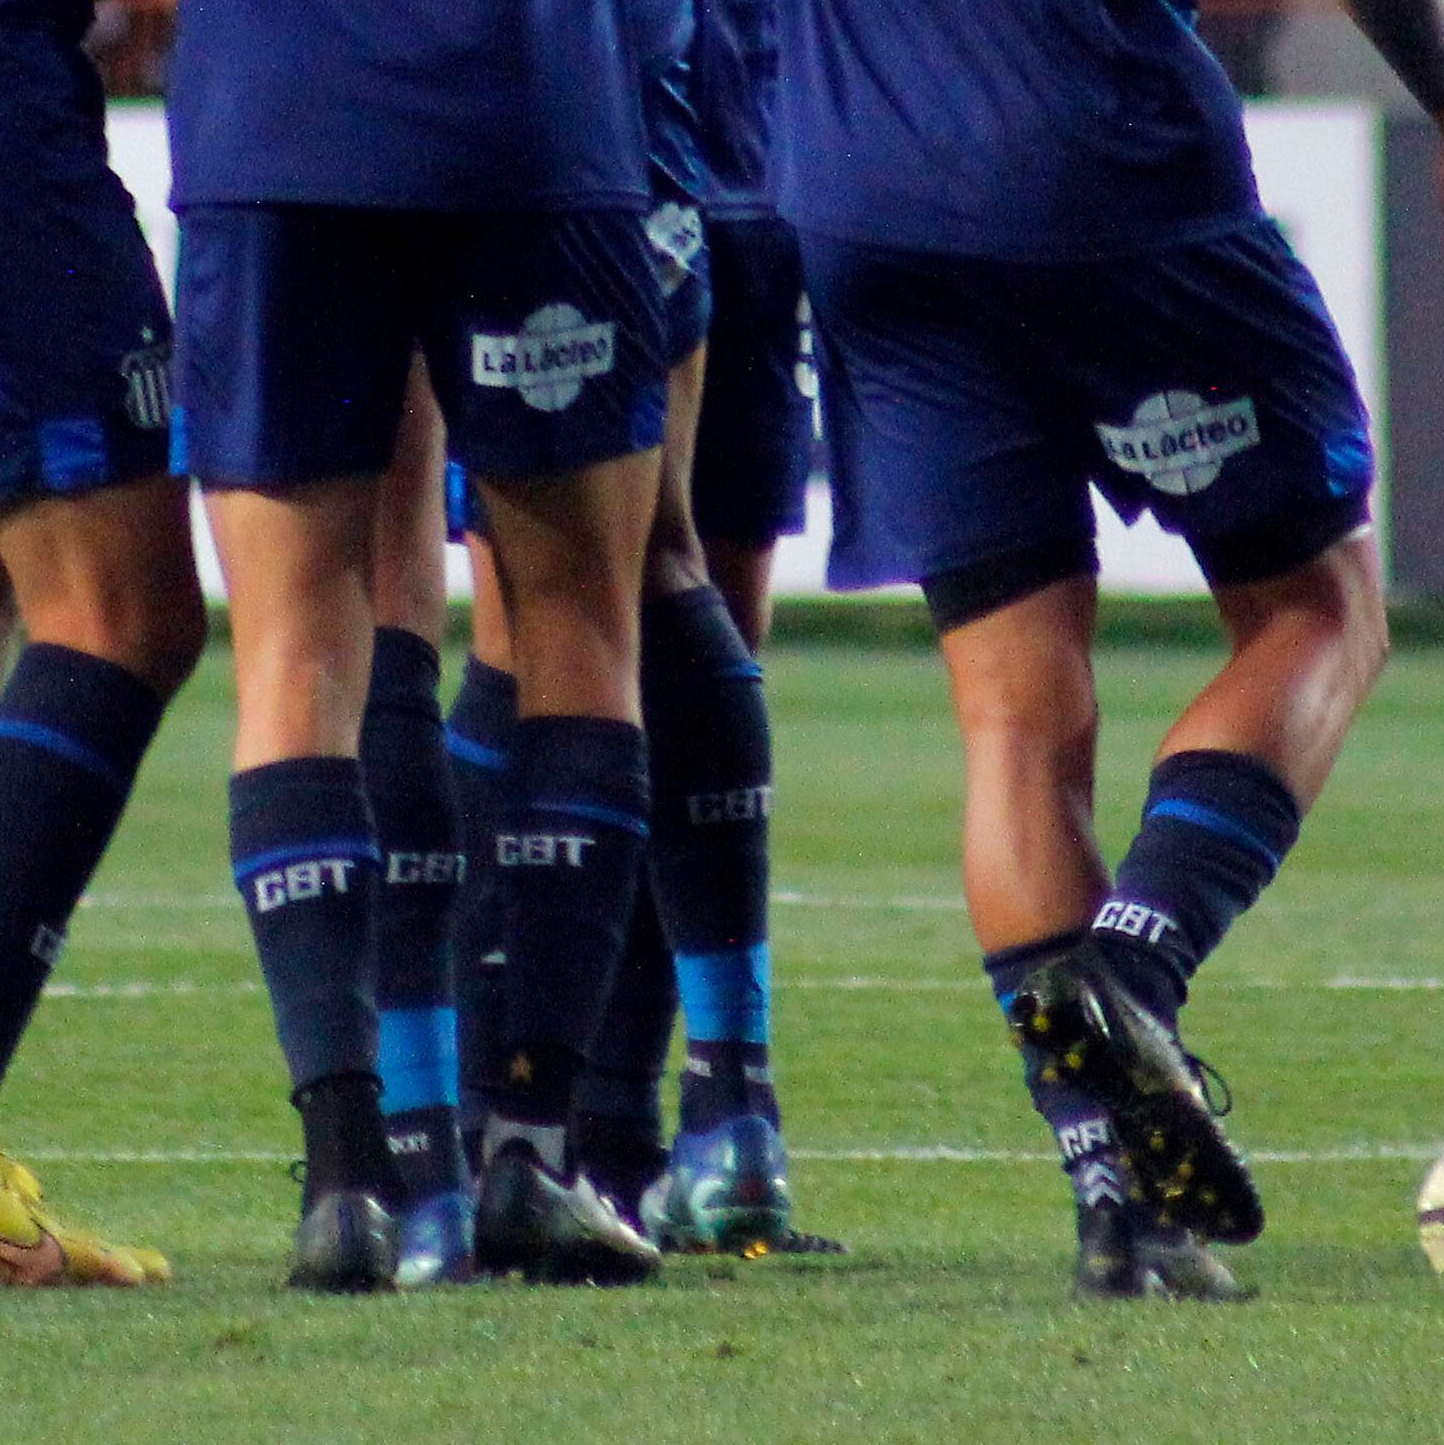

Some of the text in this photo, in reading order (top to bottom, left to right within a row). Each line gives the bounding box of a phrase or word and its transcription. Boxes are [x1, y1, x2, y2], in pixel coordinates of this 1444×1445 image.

[495, 834, 597, 868] GBT
[255, 858, 356, 914] GBT
[1091, 901, 1179, 944] GBT
